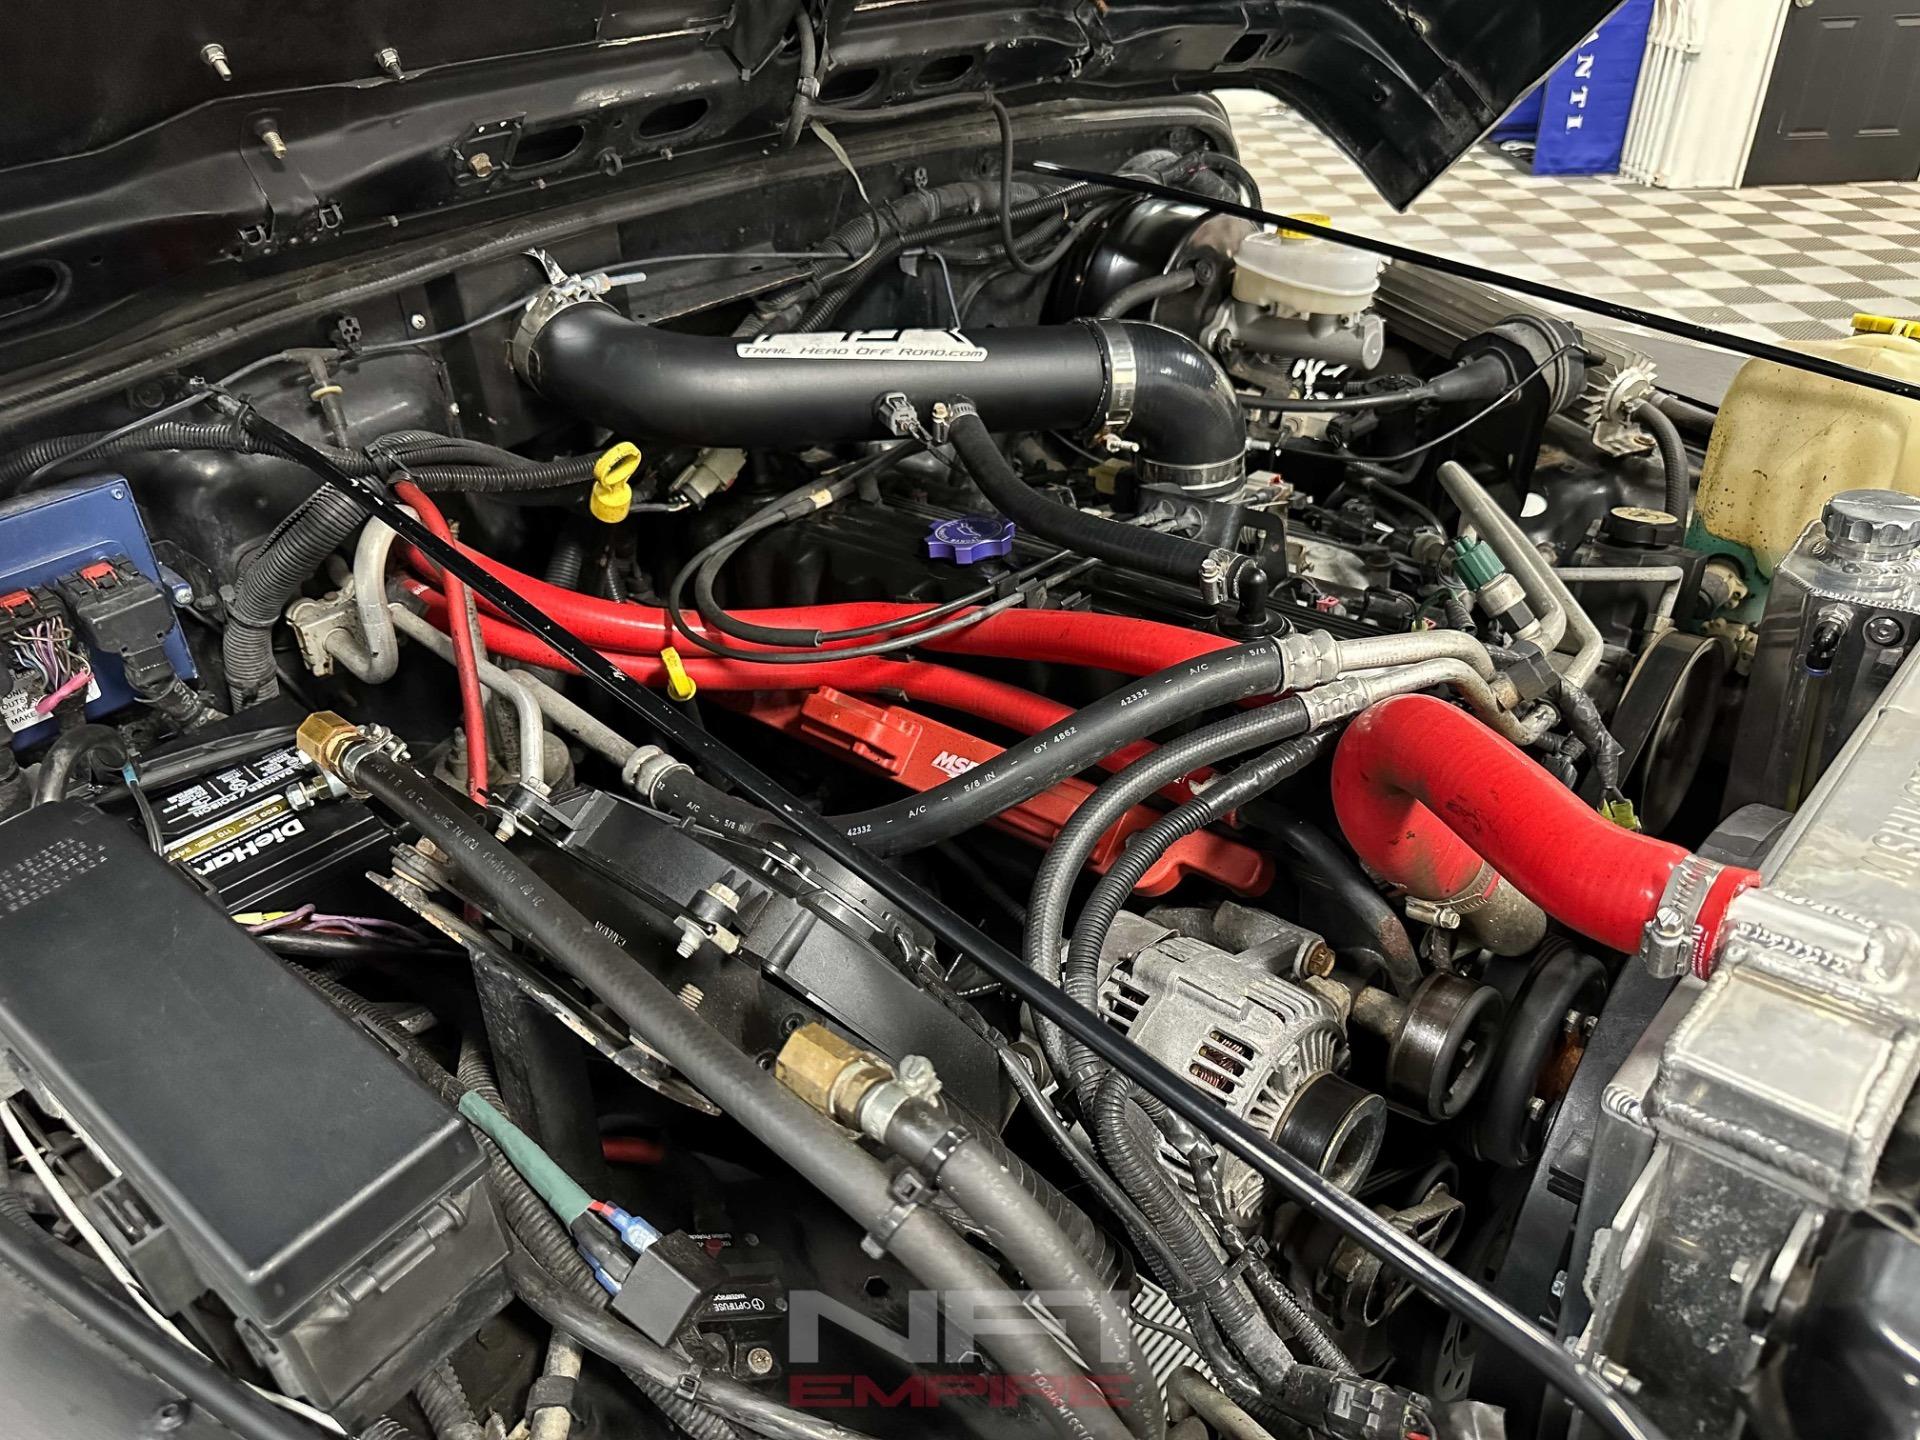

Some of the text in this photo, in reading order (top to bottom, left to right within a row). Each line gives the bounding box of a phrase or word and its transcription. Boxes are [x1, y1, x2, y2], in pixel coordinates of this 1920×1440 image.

[743, 346, 791, 355] TRAIL
[799, 346, 849, 356] HEAD
[855, 346, 894, 357] OFF
[1119, 688, 1151, 707] 42332
[1189, 663, 1209, 676] A/C
[847, 726, 1078, 837] 42332 A/C 5/8 IN GY 4862
[686, 801, 701, 813] A/C
[723, 819, 736, 830] 5/8
[194, 818, 306, 875] DieHar
